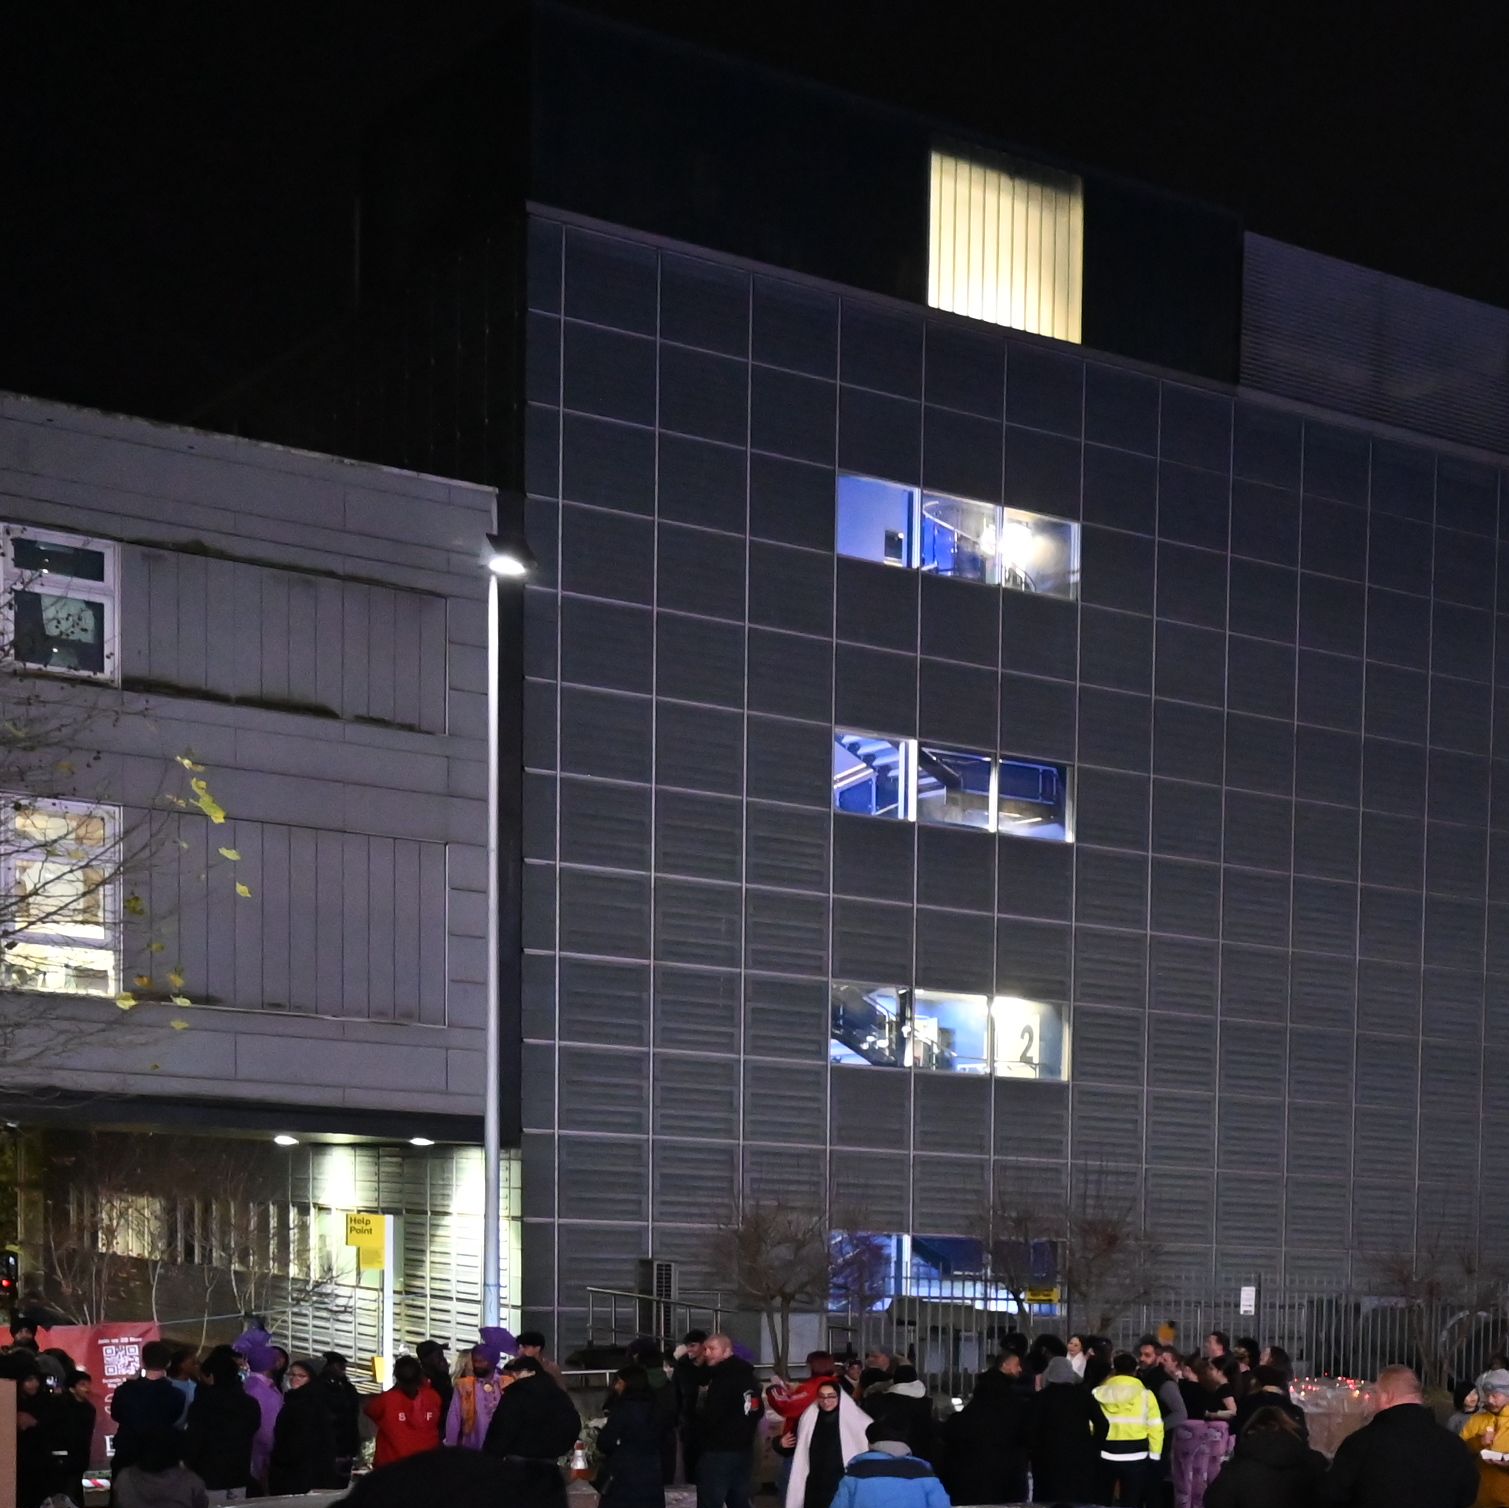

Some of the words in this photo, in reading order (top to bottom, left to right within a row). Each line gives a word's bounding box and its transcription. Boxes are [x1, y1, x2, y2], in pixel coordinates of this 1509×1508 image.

[1020, 1025, 1033, 1063] 2
[350, 1216, 371, 1226] Help
[350, 1226, 373, 1235] Point
